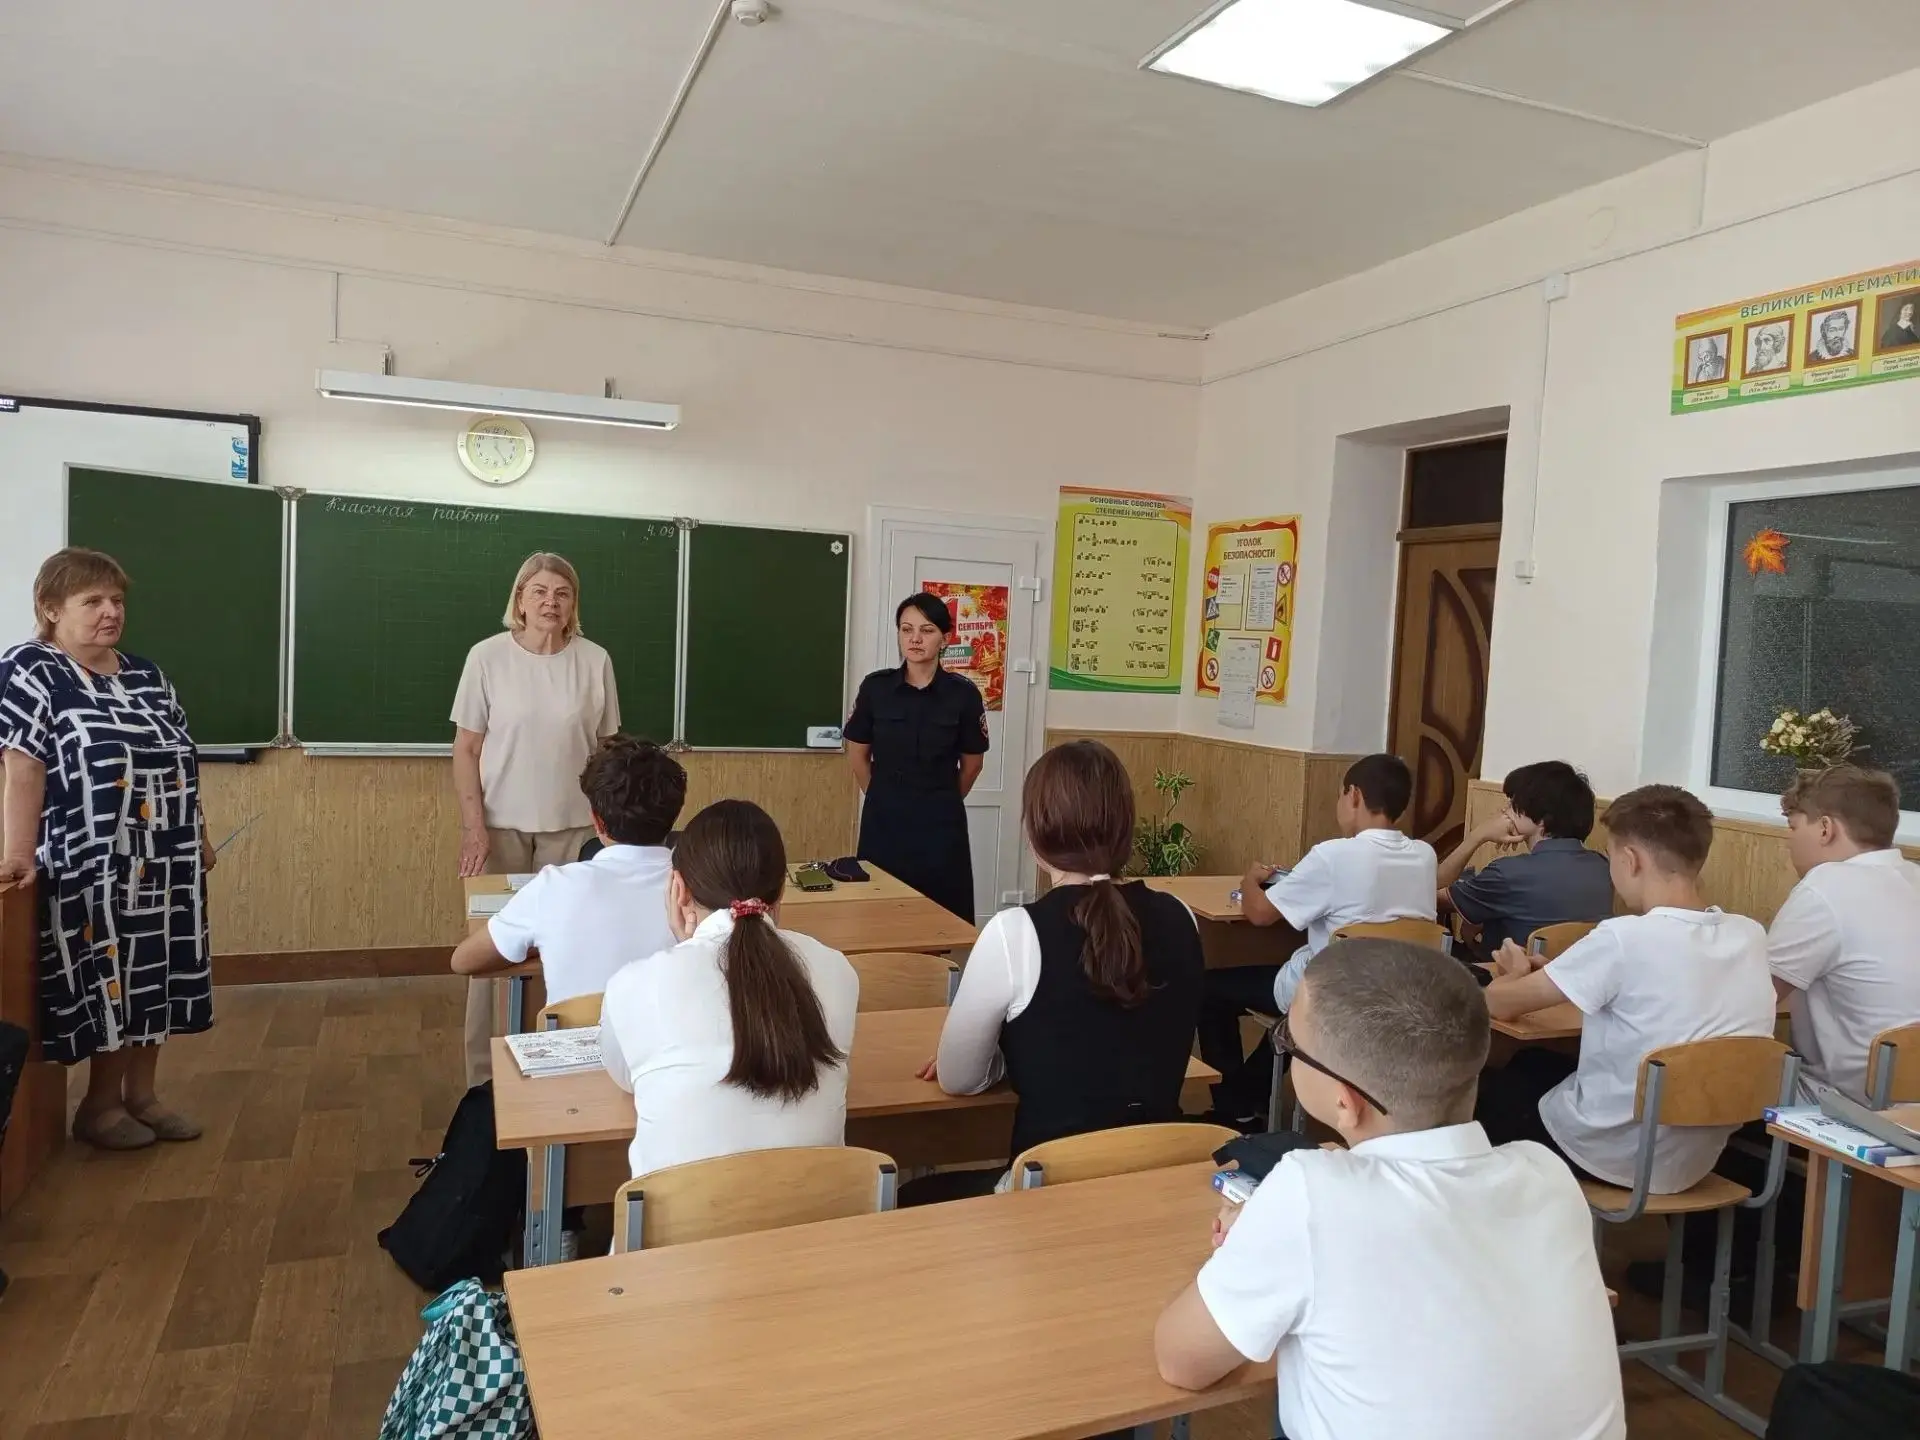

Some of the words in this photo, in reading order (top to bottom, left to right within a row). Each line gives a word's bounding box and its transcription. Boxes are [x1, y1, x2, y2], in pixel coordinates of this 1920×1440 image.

[1740, 291, 1816, 319] ВЕЛИКИЕ
[1820, 267, 1920, 301] МАТЕМАТИ
[325, 496, 416, 518] Классная
[1089, 496, 1129, 506] ОСНОВНЫЕ
[1130, 499, 1167, 509] СВОЙСТВА
[1236, 537, 1262, 547] УГОЛОК
[1223, 548, 1276, 560] БЕЗОПАСНОСТИ
[958, 621, 994, 631] СЕНТЯБРЯ
